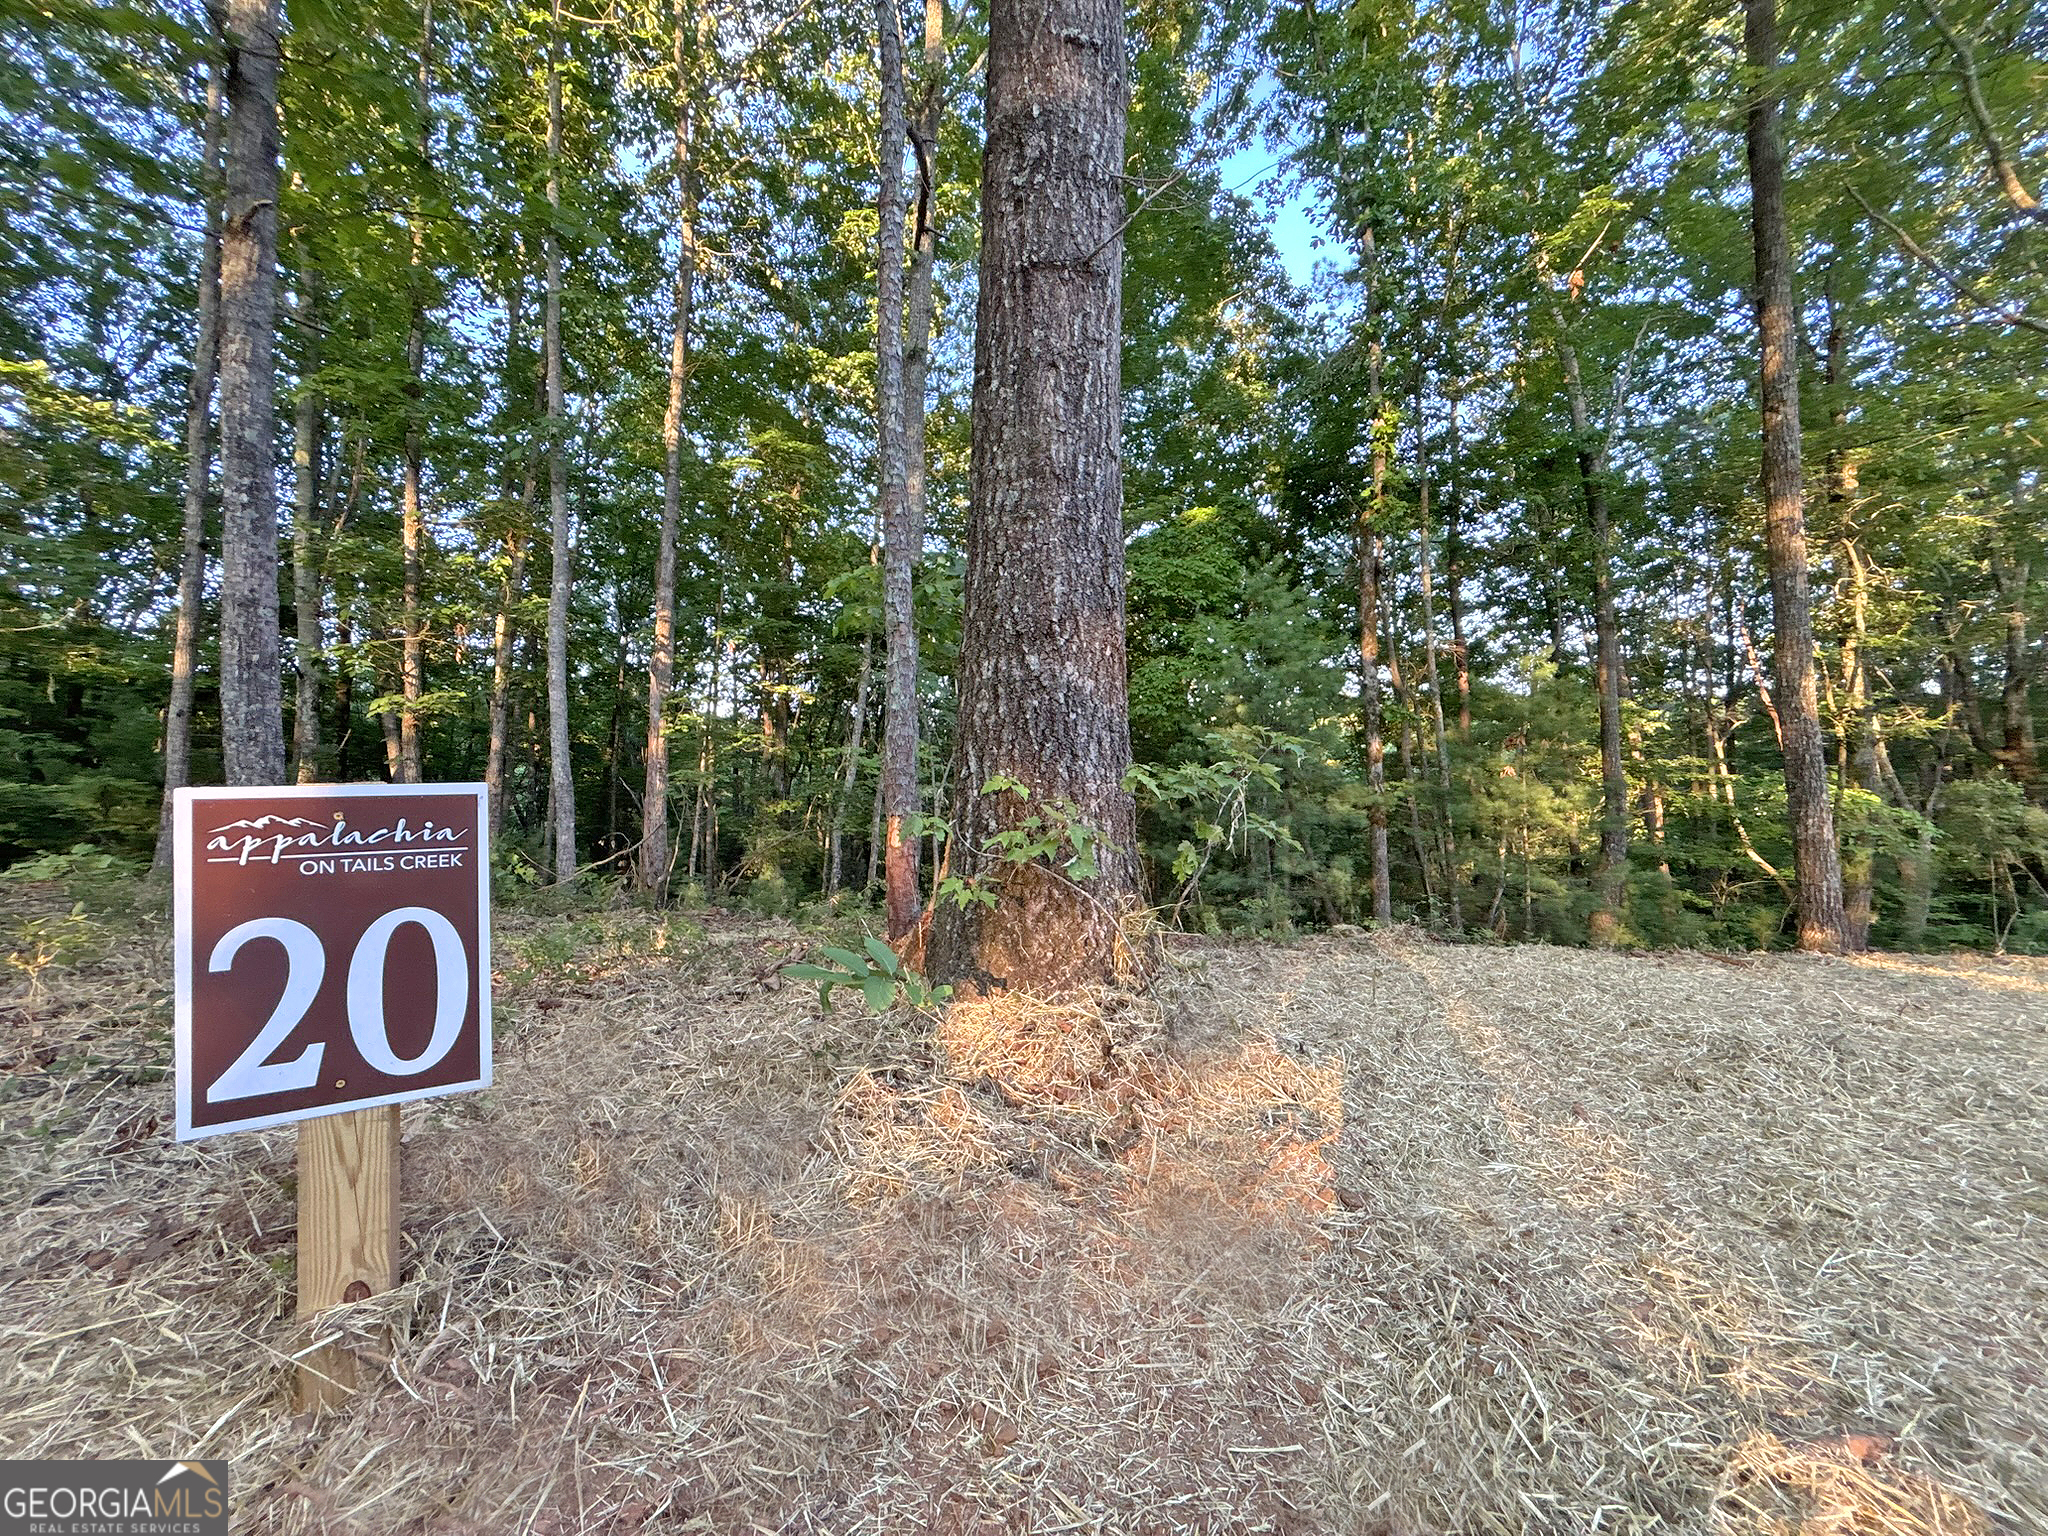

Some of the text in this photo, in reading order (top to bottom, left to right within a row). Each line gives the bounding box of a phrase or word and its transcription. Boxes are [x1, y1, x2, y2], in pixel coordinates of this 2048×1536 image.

[207, 818, 468, 866] appalachia
[299, 853, 463, 875] ON TAILS CREEK
[207, 906, 469, 1103] 20
